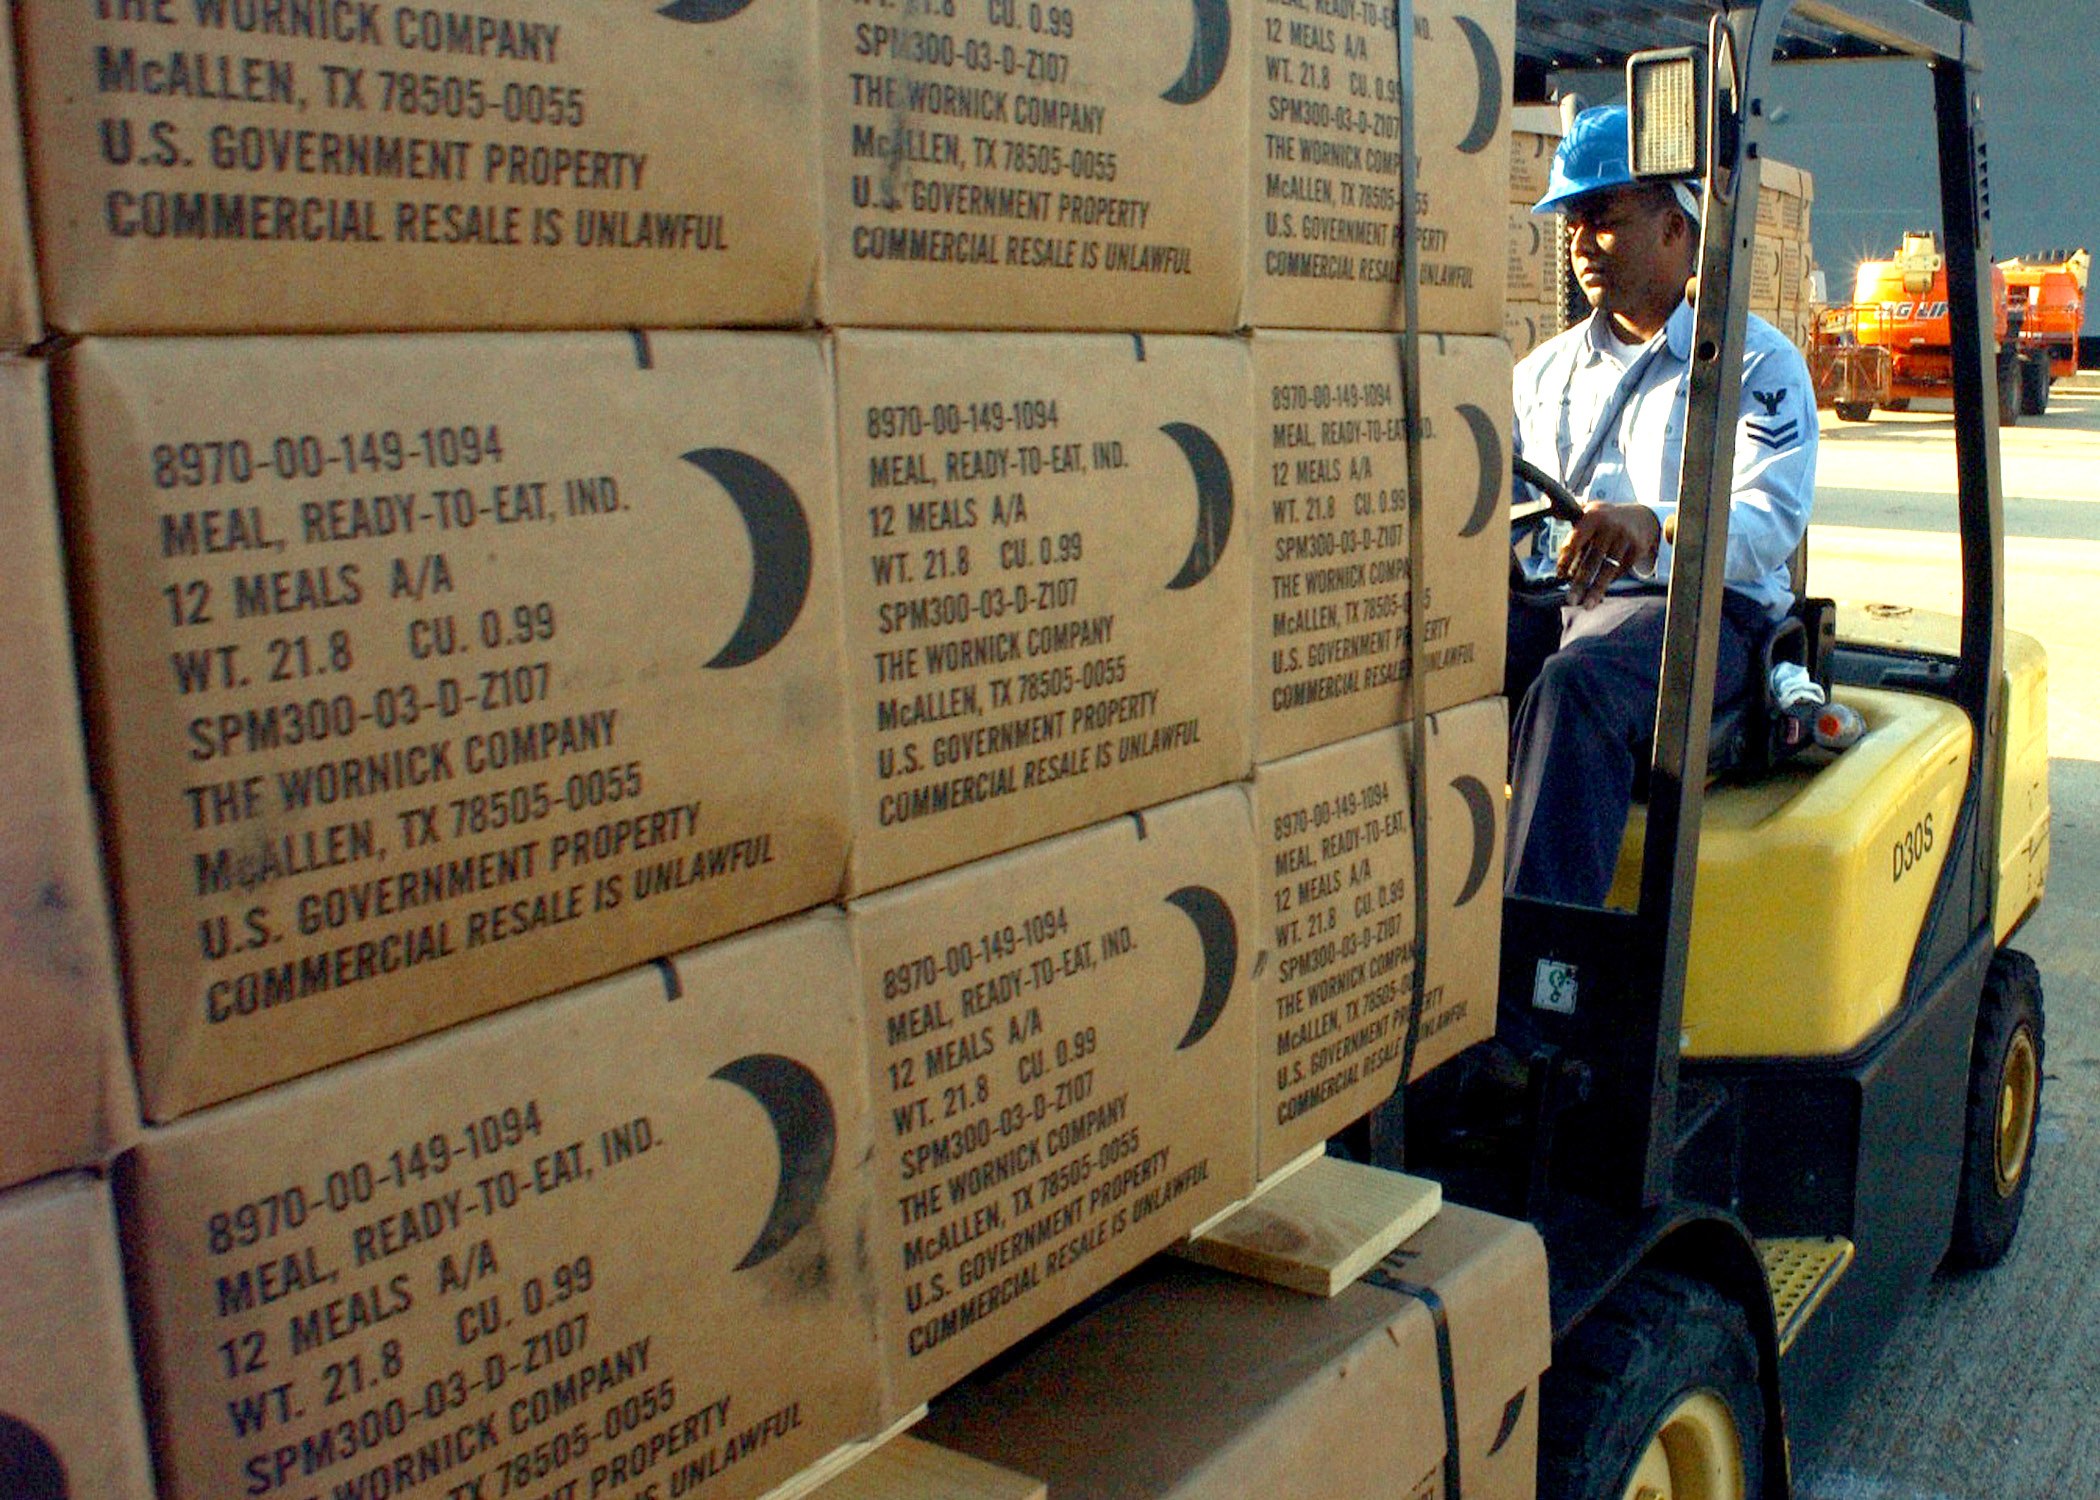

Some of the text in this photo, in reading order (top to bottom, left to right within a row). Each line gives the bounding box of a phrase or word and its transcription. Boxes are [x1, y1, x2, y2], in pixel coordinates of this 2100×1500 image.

[193, 0, 559, 63] WORNICK COMPANY
[1028, 3, 1073, 39] 0.99
[97, 46, 584, 126] McALLEN, TX 78505-0055
[908, 82, 1007, 123] WORNICK
[1015, 95, 1105, 135] COMPANY
[101, 119, 647, 190] U.S. GOVERNMENT PROPERTY
[973, 138, 996, 170] TX
[1004, 142, 1116, 181] 78505-0055
[106, 190, 728, 251] COMMERCIAL RESALE IS UNLAWFUL
[912, 181, 1150, 229] GOVERNMENT PROPERTY
[853, 226, 1191, 275] COMMERCIAL RESALE IS UNLAWFUL
[153, 425, 504, 488] 8970-00-149-1094
[867, 401, 1059, 438] 8970-00-149-1094
[870, 452, 936, 487] MEAL,
[1094, 441, 1128, 470] IND.
[163, 504, 286, 558] MEAL,
[566, 475, 630, 518] IND.
[869, 494, 1027, 537] 12 MEALS A/A
[871, 532, 1082, 586] WT. 21.8 CU. 0.99
[163, 553, 454, 626] 12 MEALS A/A
[172, 603, 555, 695] WT. 21.8 CU. 0.99
[874, 615, 1114, 683] THE WORNICK COMPANY
[878, 656, 1126, 730] McALLEN, TX 78505-0055
[278, 739, 453, 812] WORNICK
[465, 710, 617, 776] COMPANY
[878, 690, 1158, 779] U.S. GOVERNMENT PROPERTY
[879, 719, 1200, 827] COMMERCIAL RESALE IS UNLAWFUL
[397, 803, 440, 852] TX
[450, 761, 642, 840] 78505-0055
[1893, 811, 1933, 883] D30S
[200, 803, 700, 960] U.S. GOVERNMENT PROPERTY
[206, 835, 773, 1024] COMMERCIAL RESALE IS UNLAWFUL
[883, 907, 1068, 999] 8970-00-149-1094
[888, 1000, 952, 1046] MEAL,
[1103, 926, 1137, 963] IND.
[888, 1007, 1043, 1091] 12 MEALS A/A
[893, 1026, 1096, 1136] WT. 21.8 CU. 0.99
[209, 1100, 543, 1256] 8970-00-149-1094
[898, 1093, 1127, 1227] THE WORNICK COMPANY
[903, 1127, 1139, 1272] McALLEN, TX 78505-0055
[217, 1246, 339, 1318] MEAL,
[602, 1113, 663, 1171] IND.
[906, 1147, 1169, 1315] U.S. GOVERNMENT PROPERTY
[908, 1158, 1208, 1357] COMMERCIAL RESALE IS UNLAWFUL
[219, 1238, 498, 1379] 12 MEALS A/A
[228, 1255, 593, 1439] WT. 21.8 CU. 0.99
[508, 1336, 651, 1436] COMPANY
[499, 1377, 676, 1490] 78505-0055
[590, 1396, 731, 1500] PROPERTY
[669, 1403, 802, 1499] UNLAWFUL
